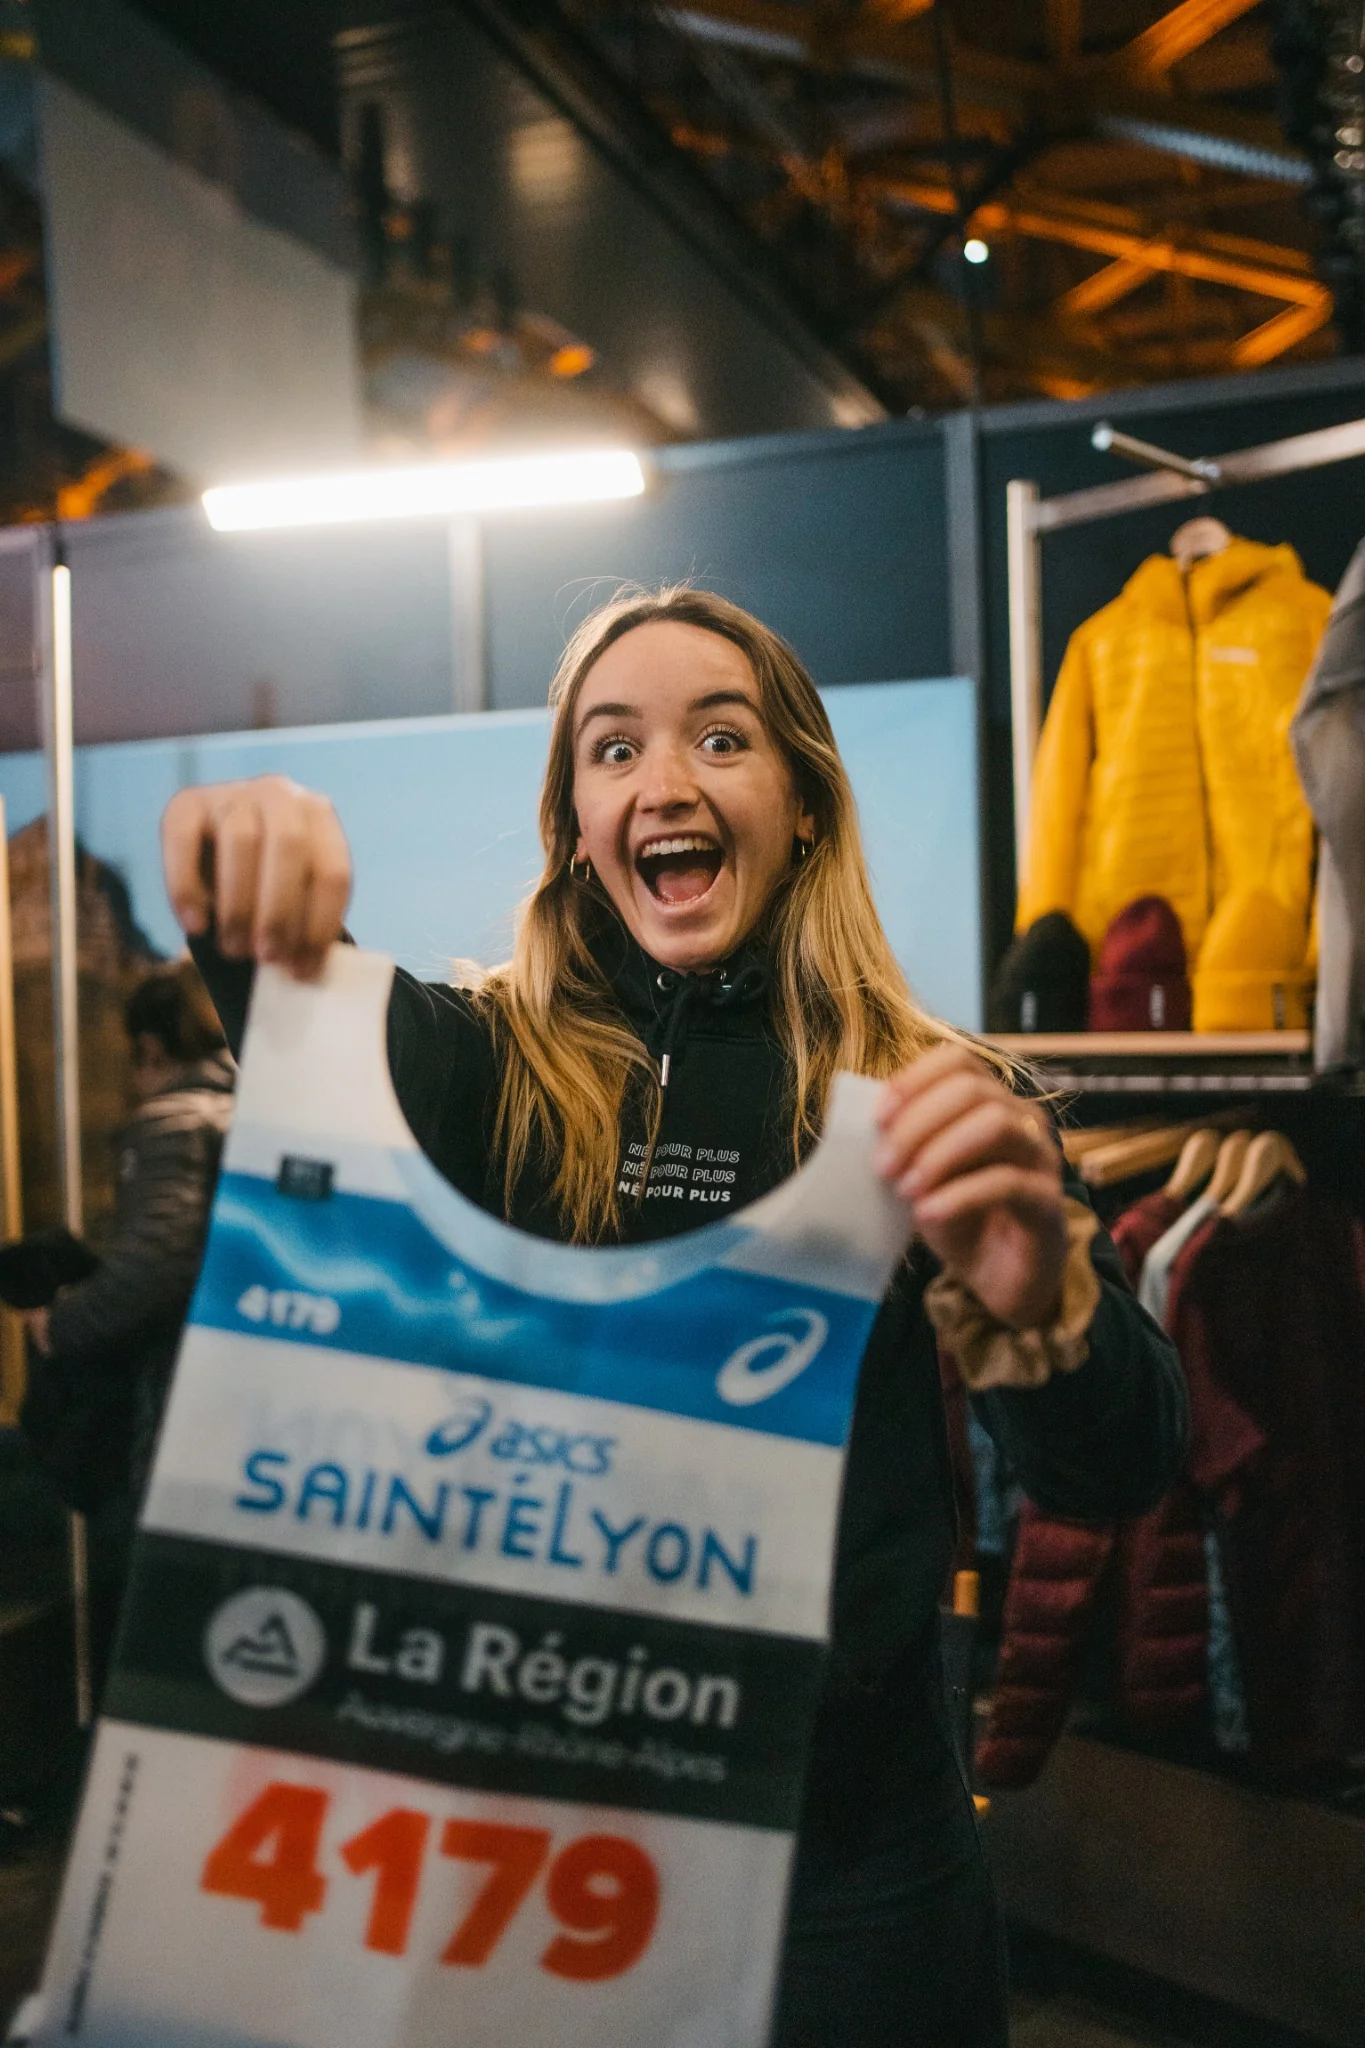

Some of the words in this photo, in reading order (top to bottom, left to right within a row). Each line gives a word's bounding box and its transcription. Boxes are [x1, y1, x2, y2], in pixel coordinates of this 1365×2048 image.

[650, 1163, 688, 1179] POUR
[692, 1168, 736, 1183] PLUS
[655, 1143, 691, 1159] POUR
[696, 1148, 740, 1163] PLUS
[617, 1180, 641, 1197] NÉ
[645, 1184, 684, 1199] POUR
[689, 1188, 731, 1202] PLUS
[236, 1284, 341, 1335] 4179
[235, 1449, 757, 1598] SAINTÉLYON
[347, 1602, 444, 1688] La
[459, 1620, 740, 1731] Région
[199, 1780, 661, 1983] 4179
